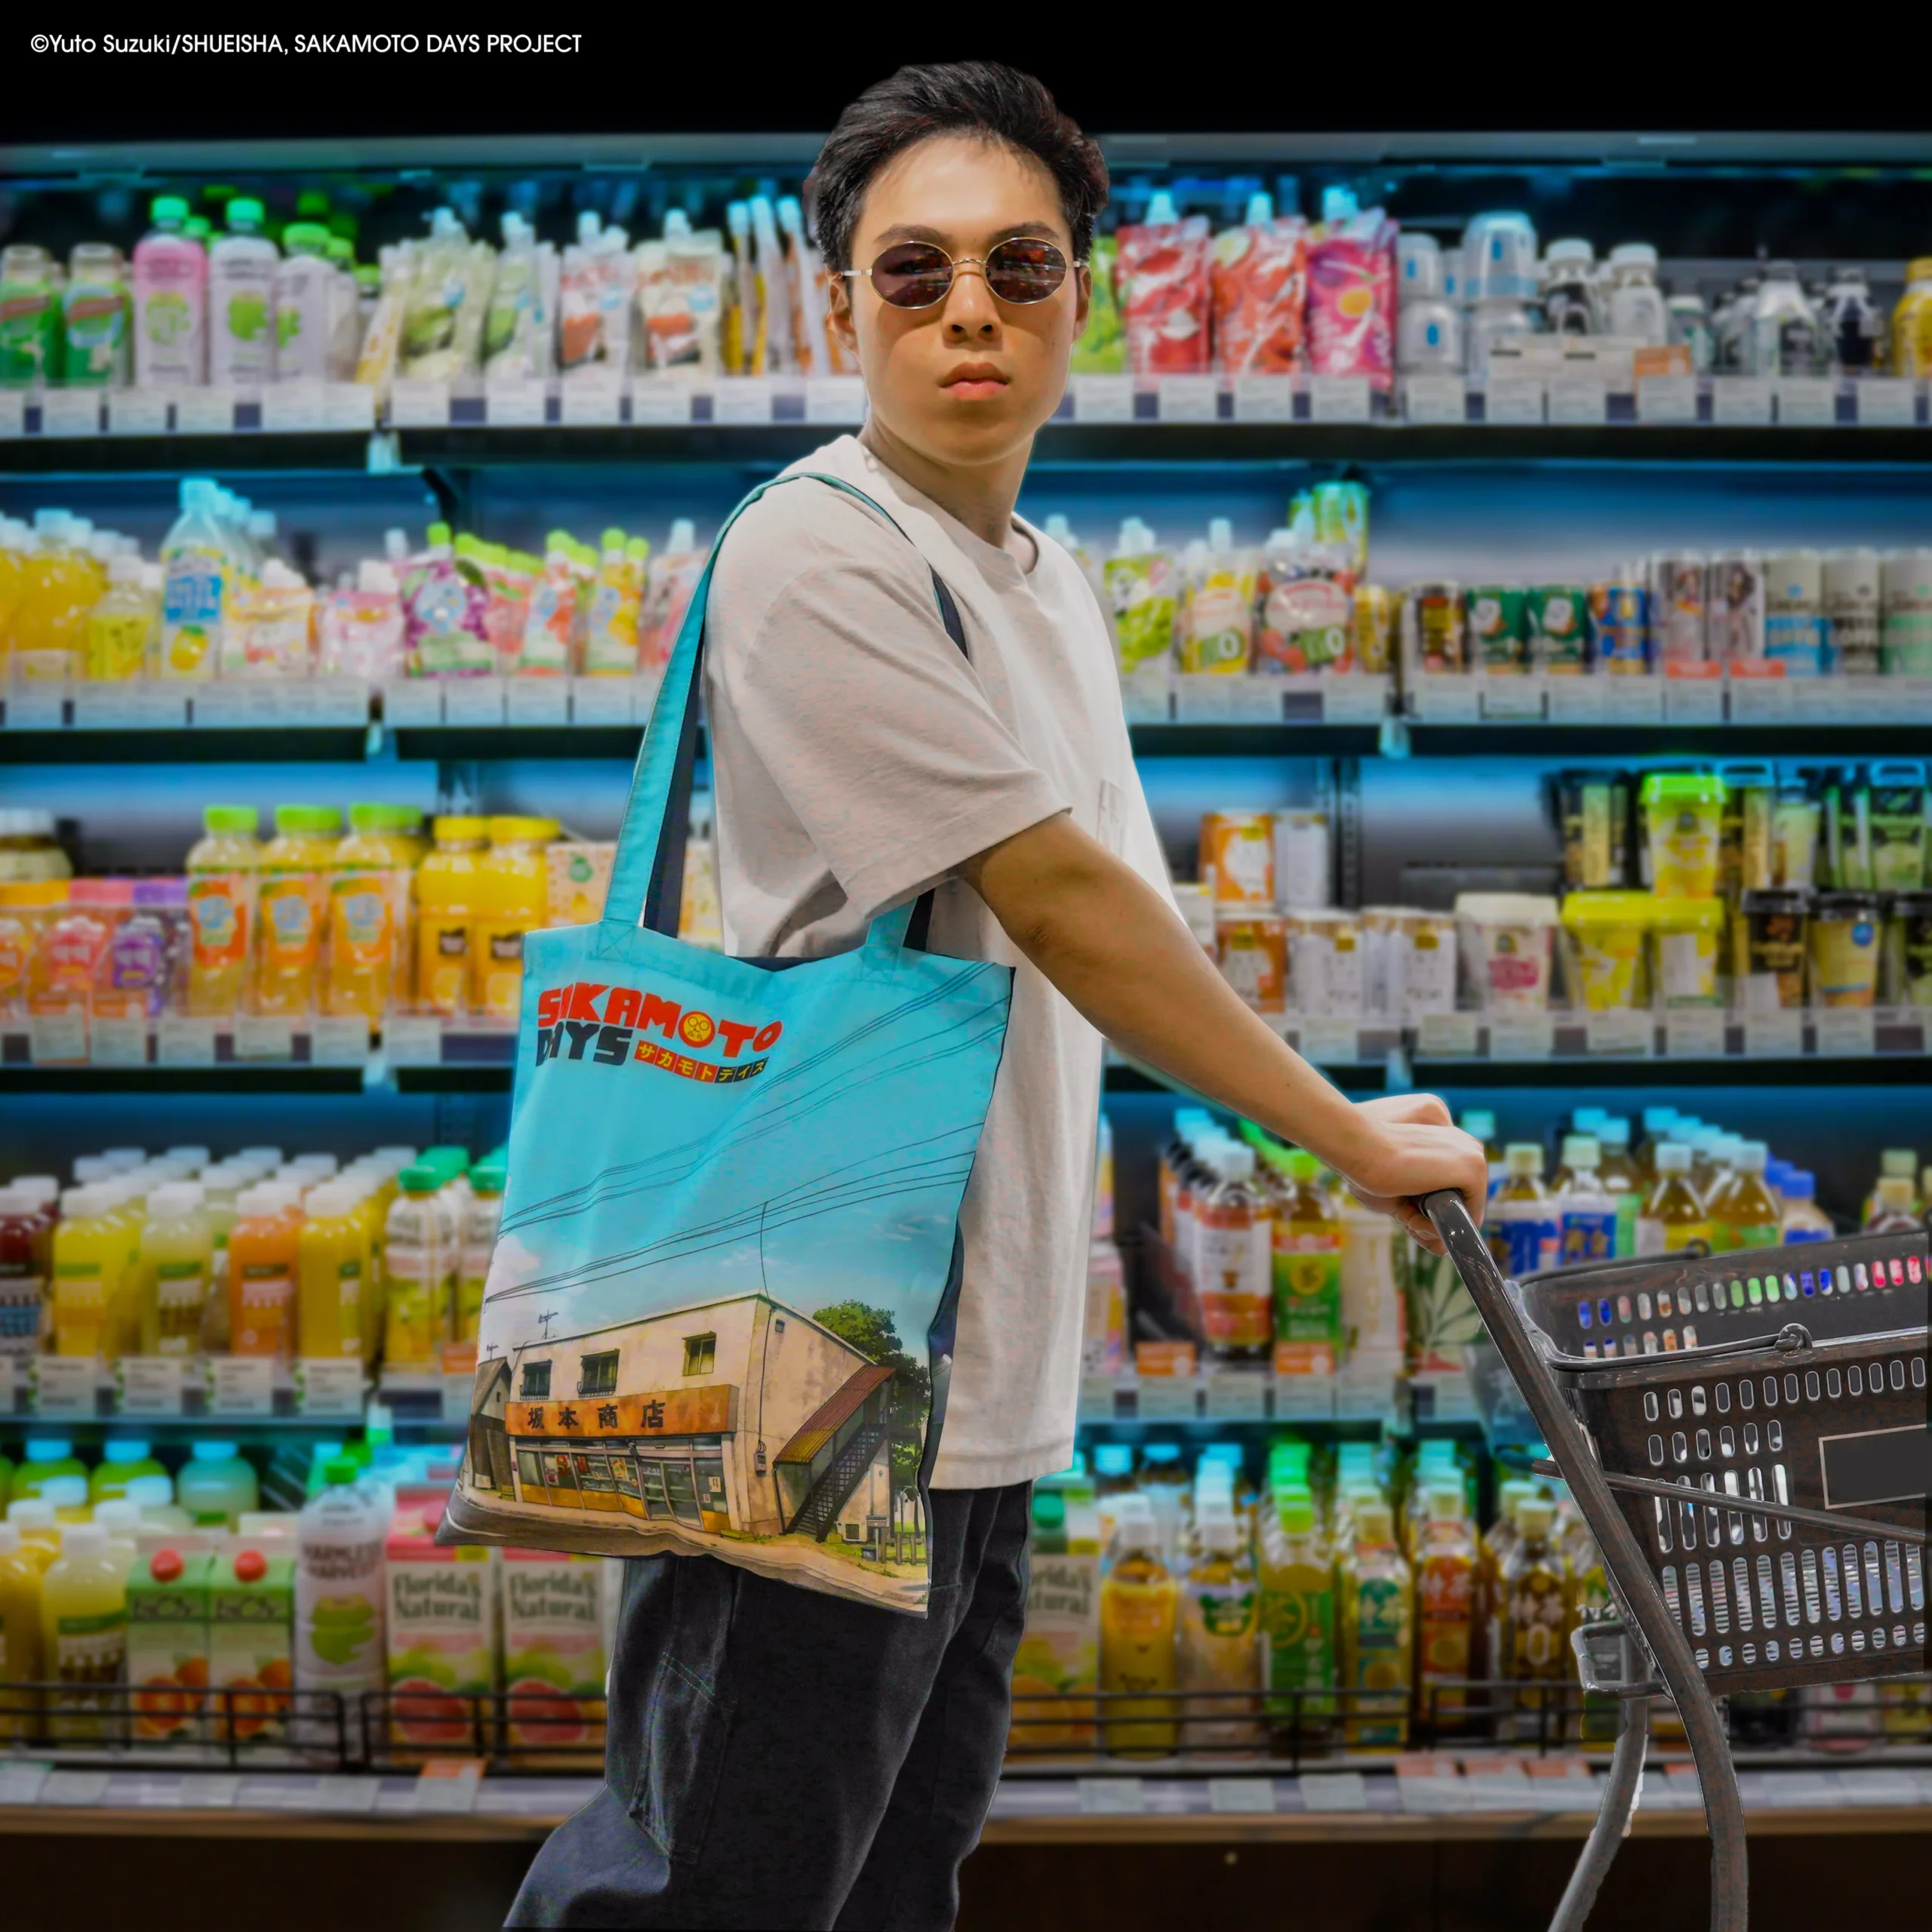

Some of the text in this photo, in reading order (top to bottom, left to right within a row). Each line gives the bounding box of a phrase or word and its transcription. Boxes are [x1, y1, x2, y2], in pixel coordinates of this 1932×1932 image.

[637, 1042, 768, 1082] サカモトデイズ
[528, 1400, 665, 1429] 坂本商店
